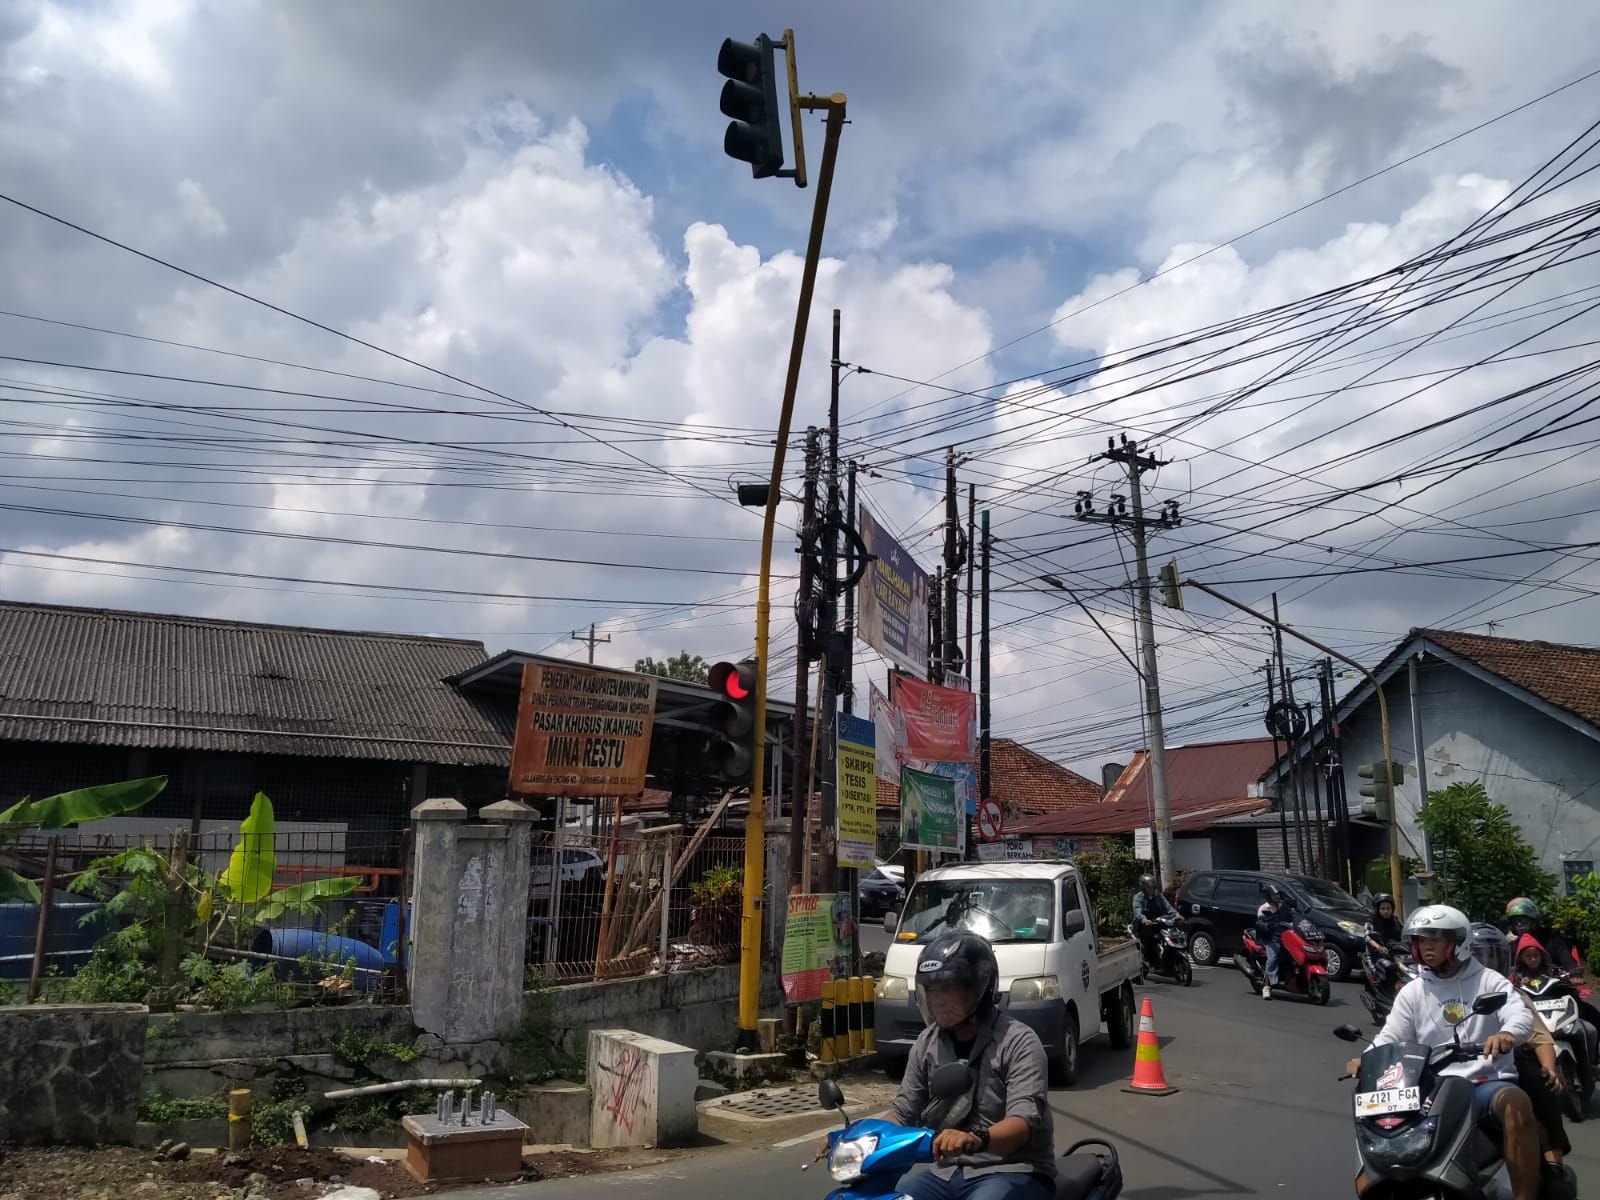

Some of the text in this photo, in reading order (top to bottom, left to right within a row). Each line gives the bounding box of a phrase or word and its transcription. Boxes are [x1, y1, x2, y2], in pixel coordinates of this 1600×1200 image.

[541, 671, 650, 699] PEMERINTAH KABUPATEN BANYUMAS
[533, 712, 644, 737] PASAR KHUSUS IKAN HIAS
[546, 736, 626, 768] MINA RESTU
[844, 757, 874, 775] SKRIPSI
[844, 773, 866, 789] TESIS
[844, 789, 872, 803] DISERTASI
[1006, 842, 1024, 851] TOKO
[788, 895, 819, 914] SPMB
[1369, 1091, 1391, 1104] 4121
[1398, 1087, 1418, 1101] FGA
